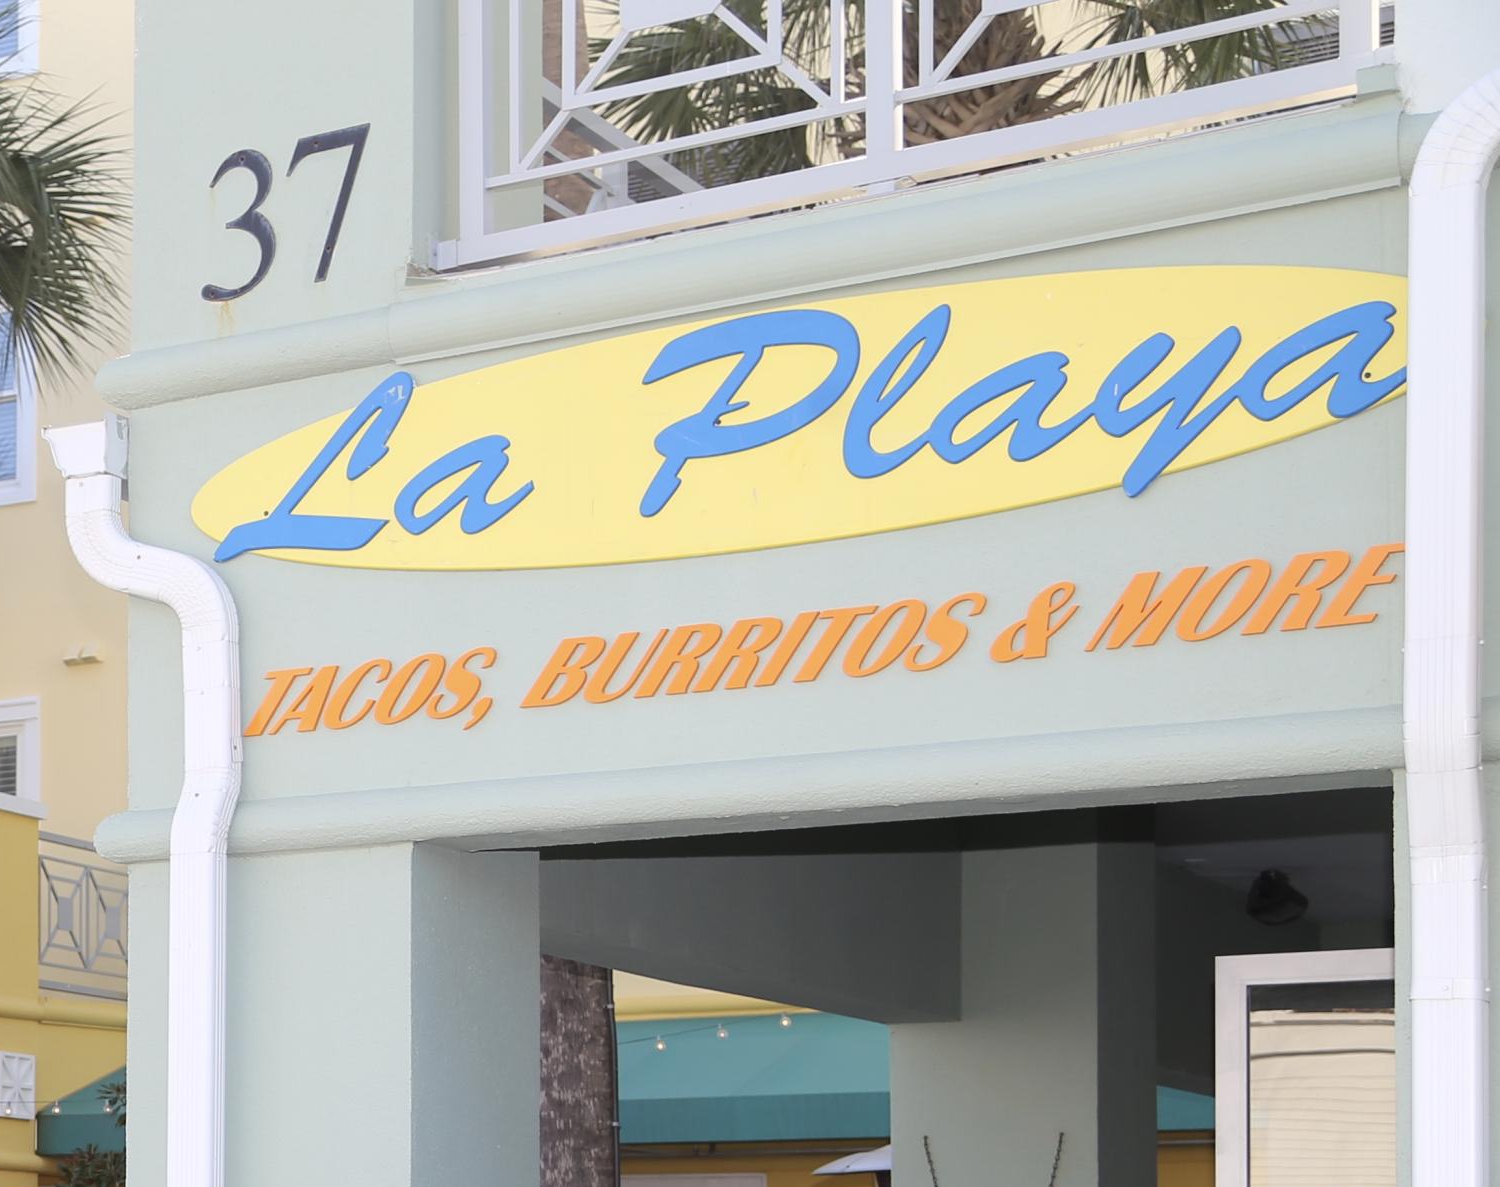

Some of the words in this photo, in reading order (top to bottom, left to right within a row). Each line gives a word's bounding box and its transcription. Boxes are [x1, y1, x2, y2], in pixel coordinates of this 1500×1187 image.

[200, 121, 371, 303] 37
[213, 370, 535, 564] La
[639, 300, 1408, 518] Playa
[244, 645, 498, 737] TACOS,
[519, 591, 988, 708] BURRITOS
[989, 580, 1080, 664] &
[1085, 542, 1407, 652] MORE
